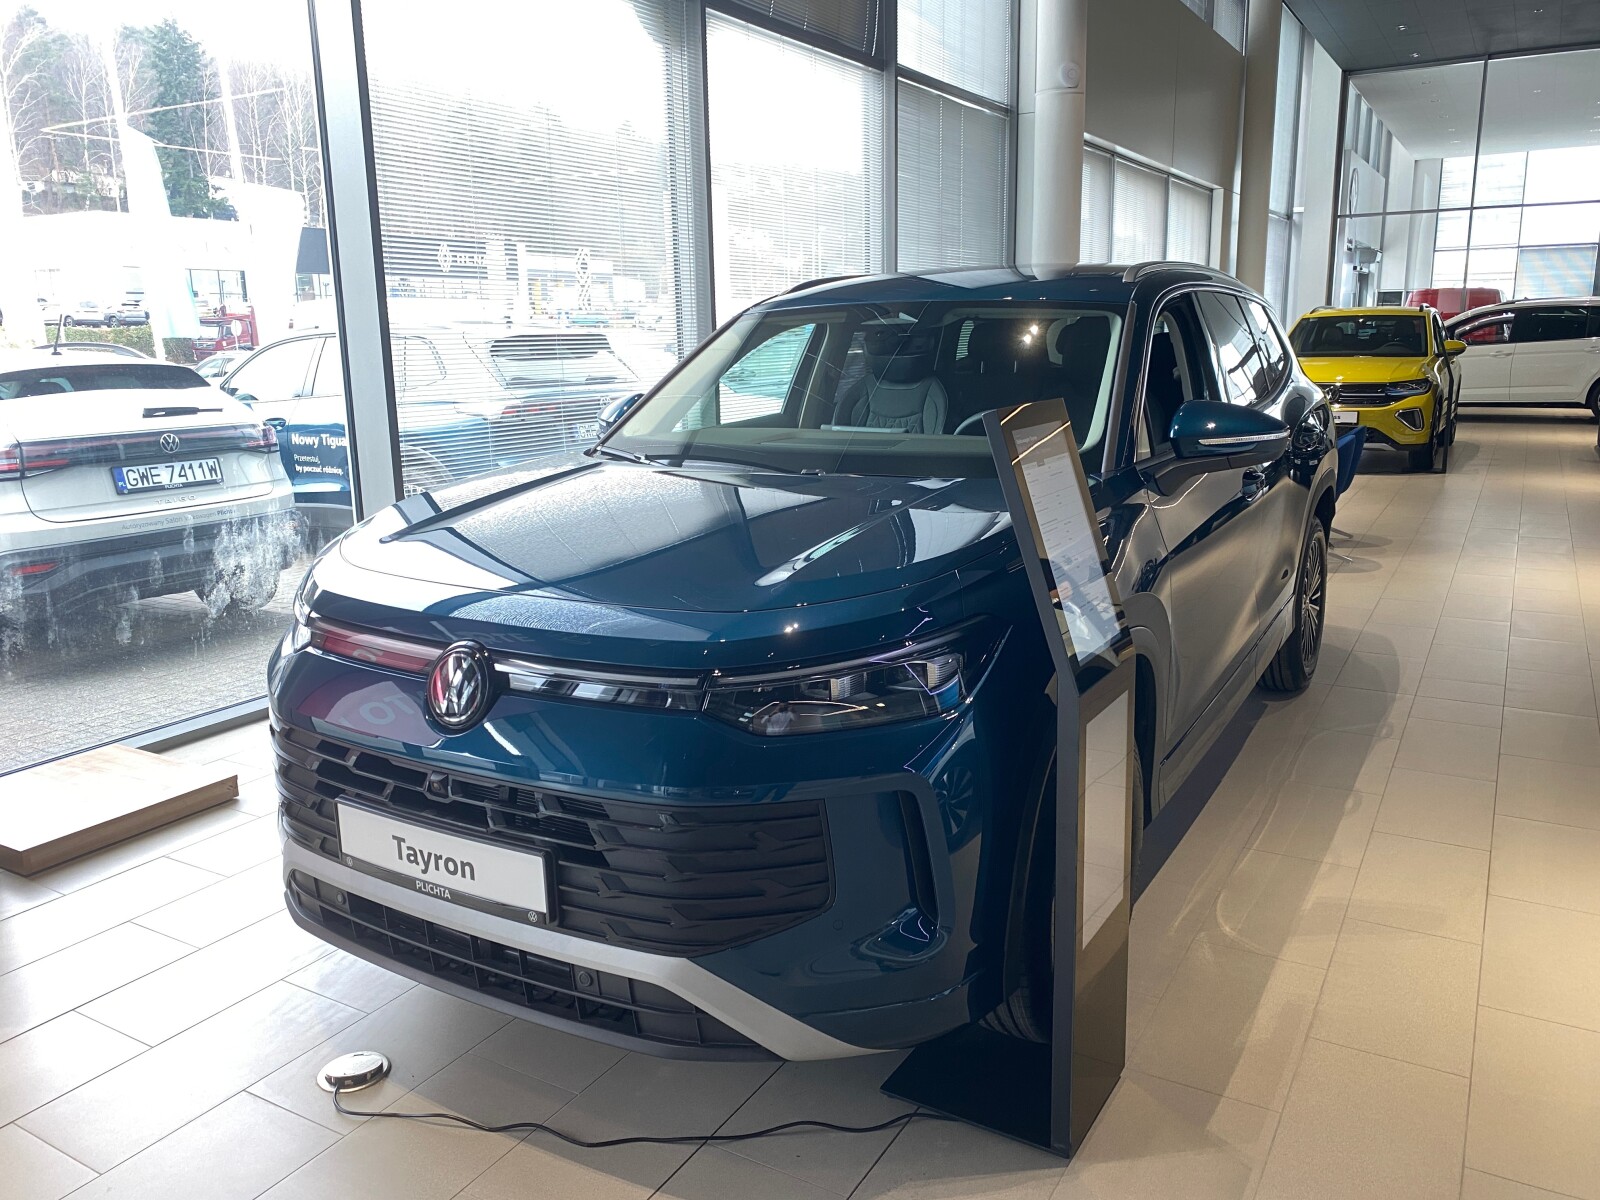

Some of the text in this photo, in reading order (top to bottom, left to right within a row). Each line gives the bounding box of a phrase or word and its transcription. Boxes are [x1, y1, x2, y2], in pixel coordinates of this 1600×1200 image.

[291, 433, 319, 449] Nowy
[126, 460, 219, 487] GWE 7411W
[295, 464, 302, 473] by
[154, 494, 196, 505] TAIGO
[121, 519, 164, 530] Autoryzowany
[165, 516, 182, 525] Salon
[184, 511, 216, 523] Vkswagen
[392, 834, 476, 881] Tayron
[415, 879, 451, 900] PLICHTA
